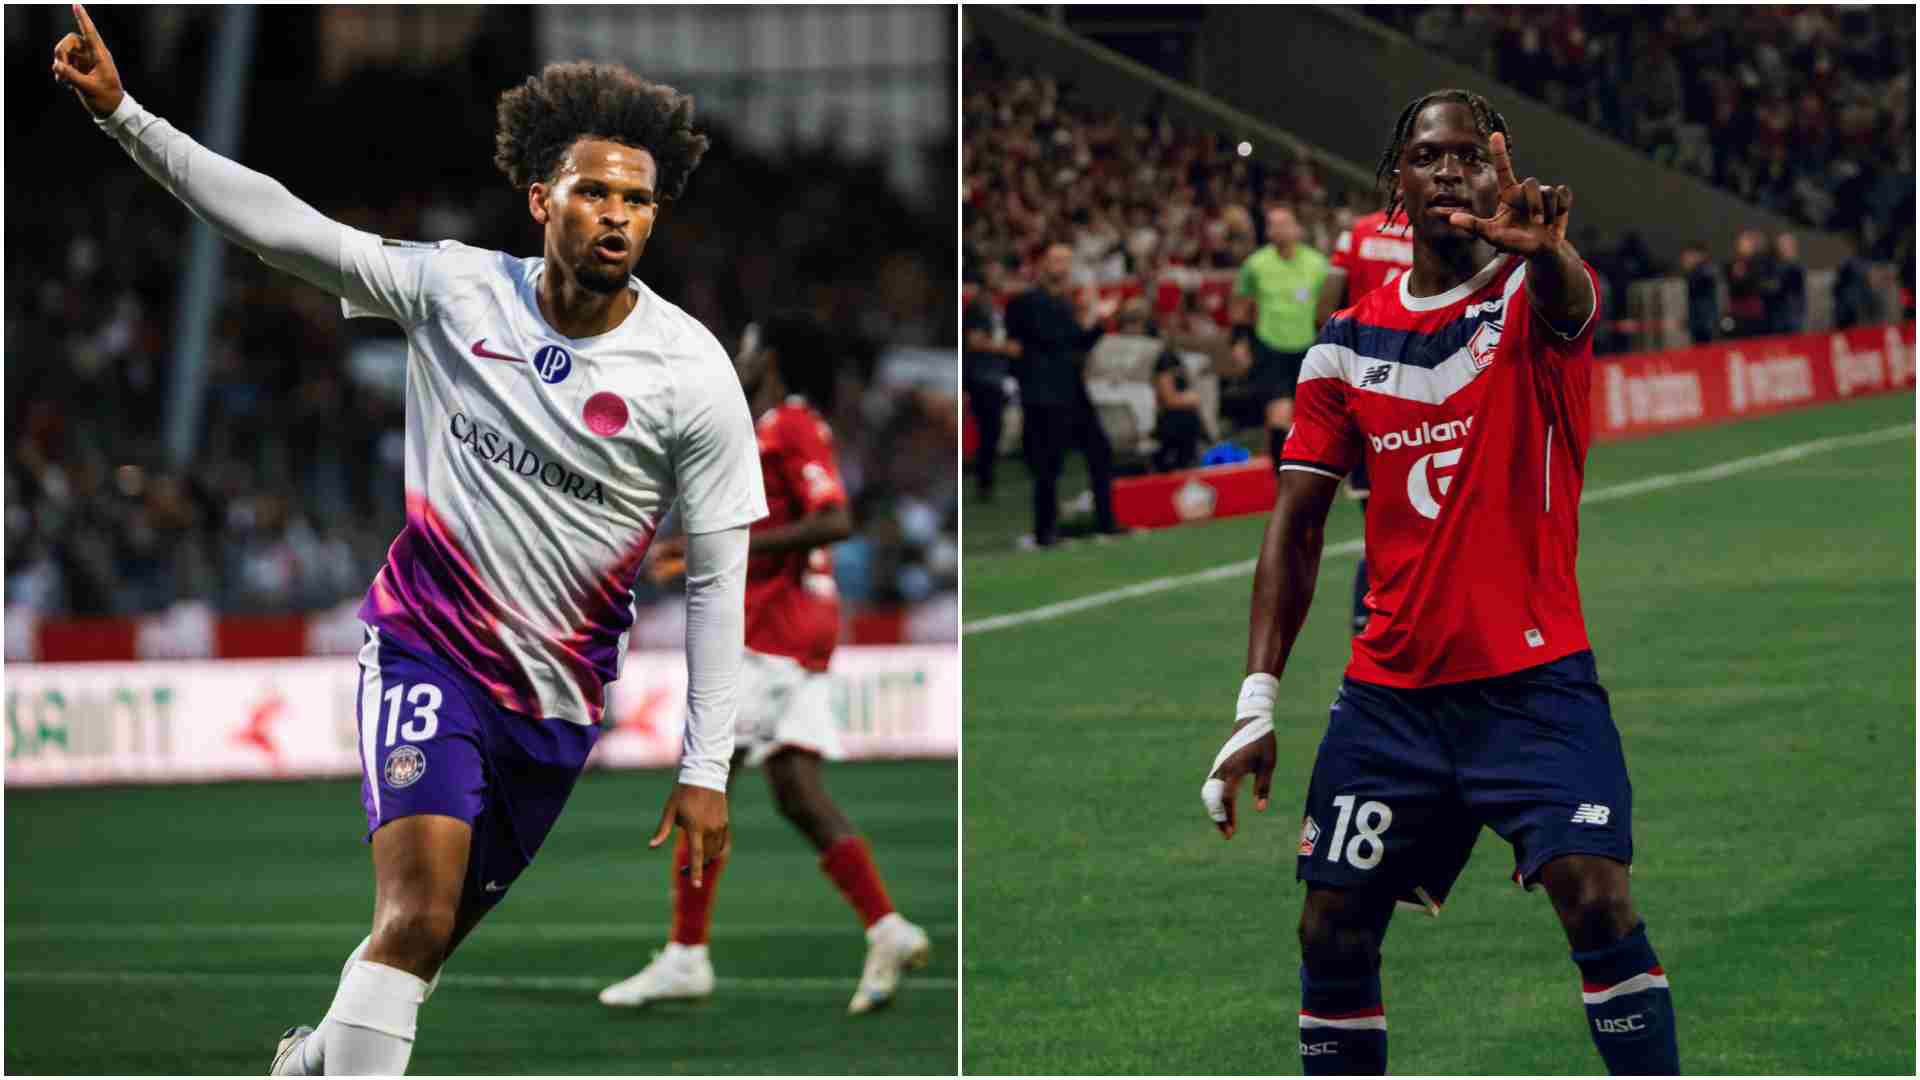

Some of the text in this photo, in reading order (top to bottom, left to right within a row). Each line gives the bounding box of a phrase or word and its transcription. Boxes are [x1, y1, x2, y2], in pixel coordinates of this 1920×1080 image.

[450, 412, 604, 505] CASADORA
[384, 683, 442, 747] 13
[1327, 795, 1393, 870] 18
[1299, 1041, 1339, 1056] OSC
[1594, 1013, 1646, 1033] LOSC
